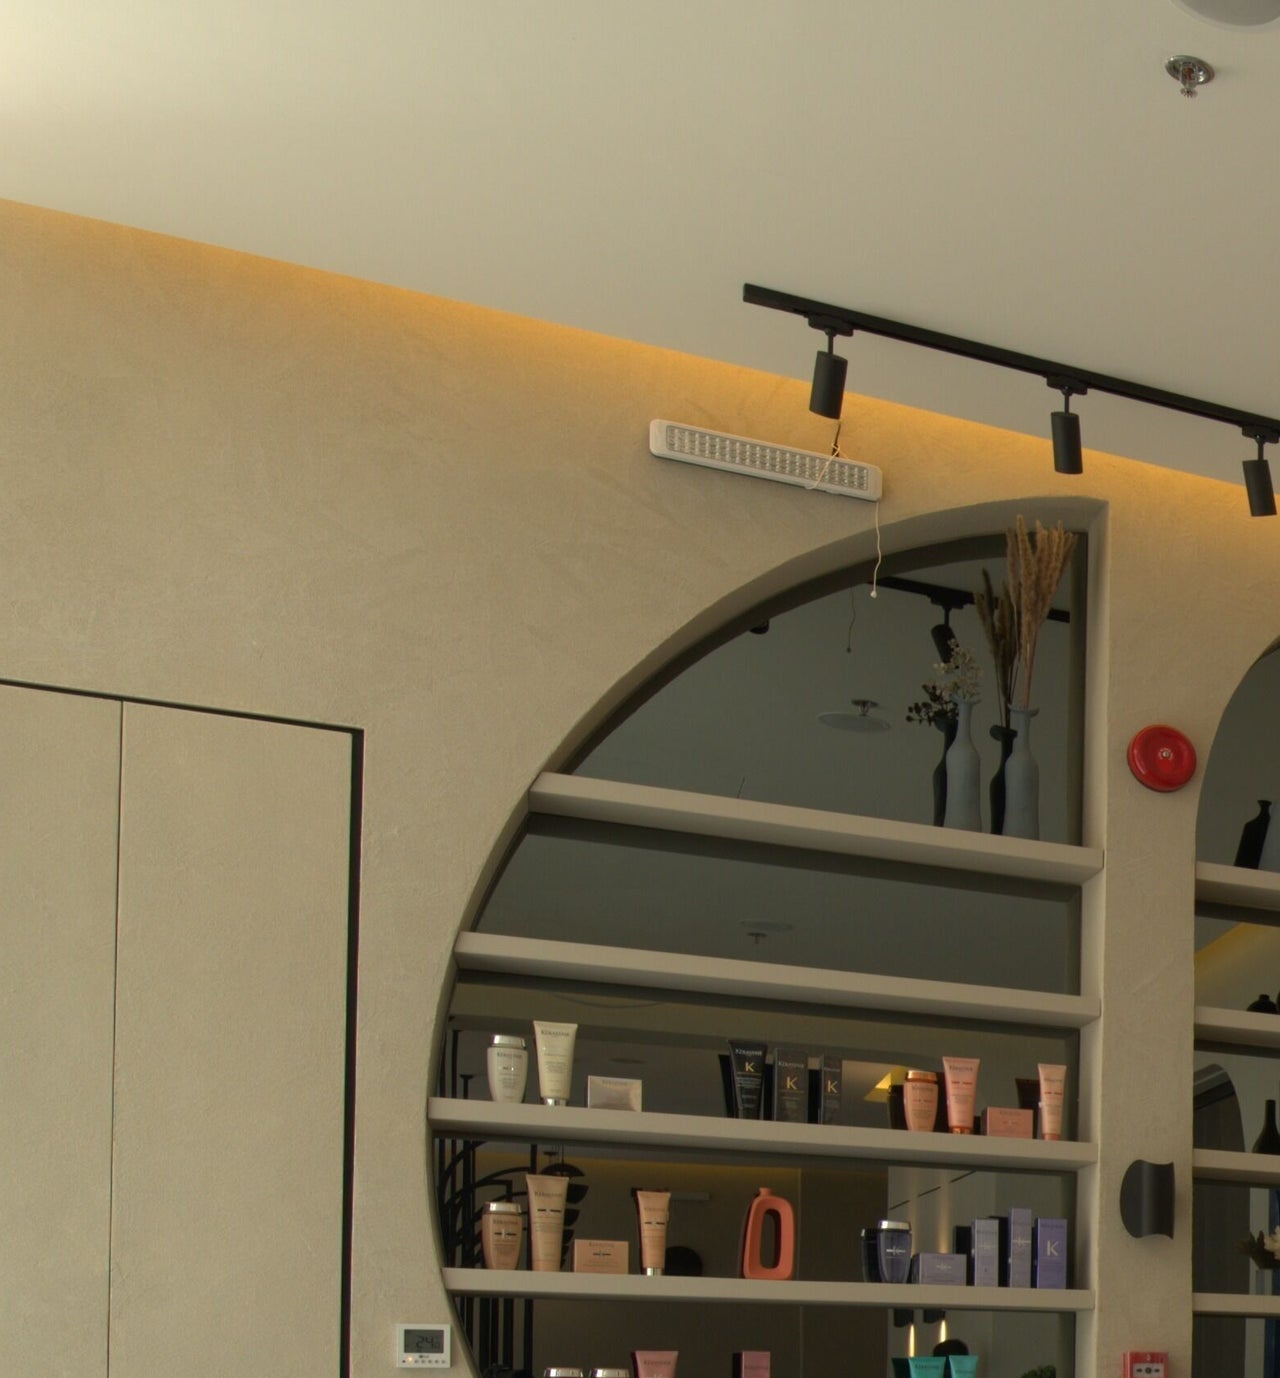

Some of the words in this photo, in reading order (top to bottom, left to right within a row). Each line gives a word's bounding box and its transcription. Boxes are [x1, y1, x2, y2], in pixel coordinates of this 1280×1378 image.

[745, 1061, 755, 1073] K
[786, 1076, 798, 1090] K
[827, 1080, 838, 1093] K
[1046, 1240, 1059, 1257] K
